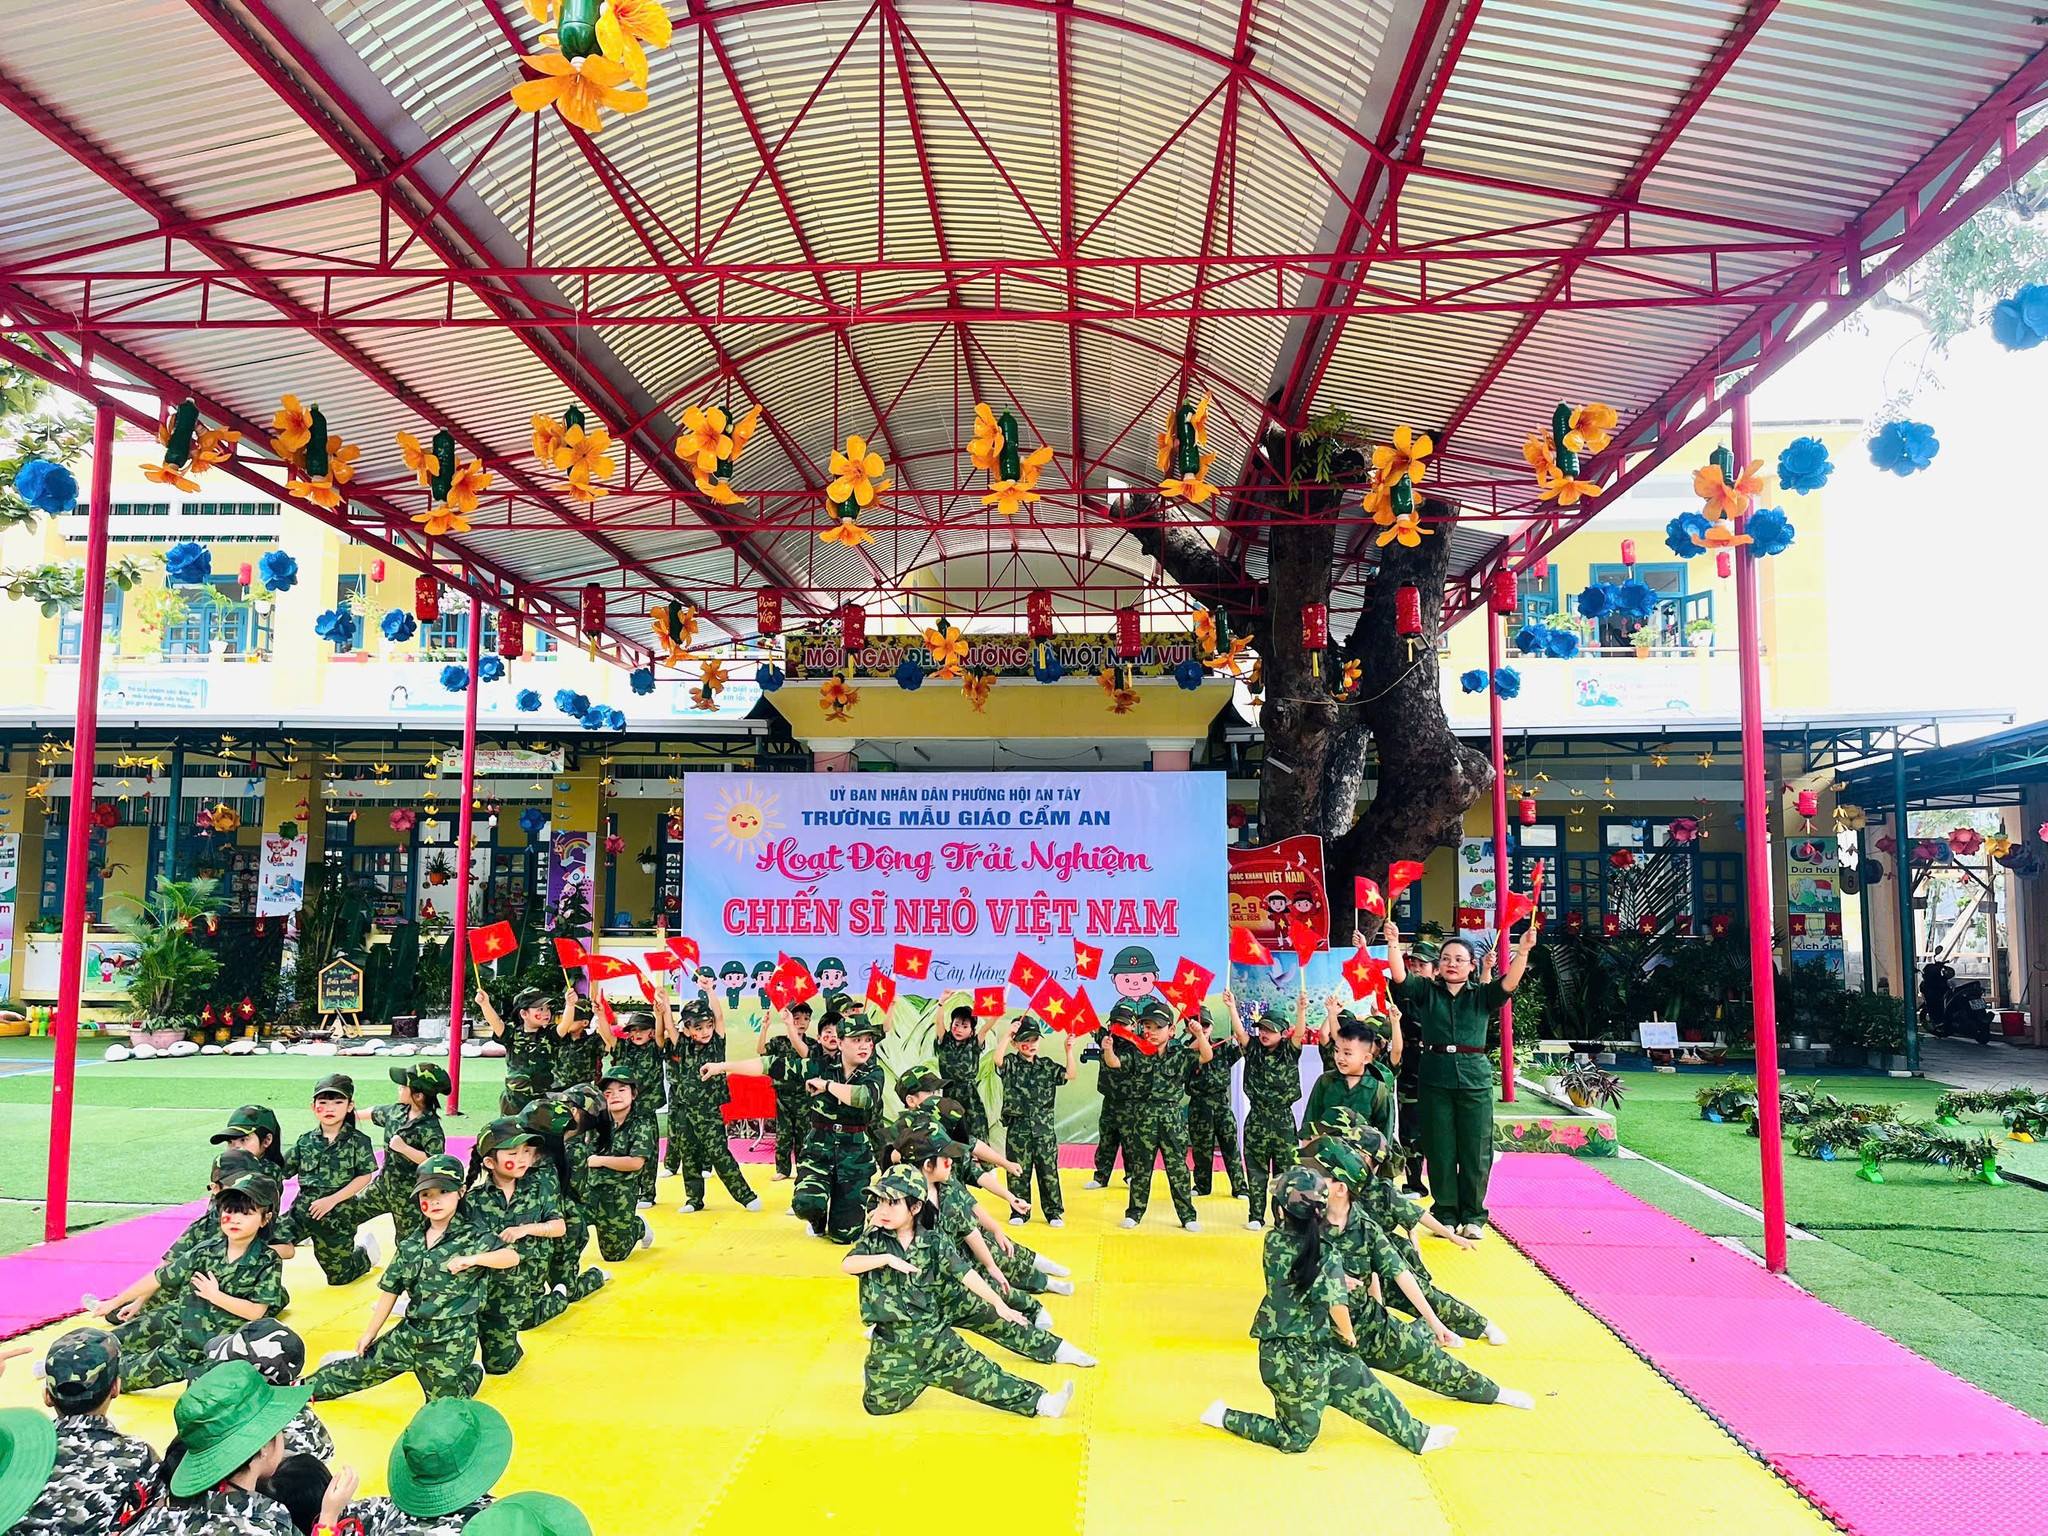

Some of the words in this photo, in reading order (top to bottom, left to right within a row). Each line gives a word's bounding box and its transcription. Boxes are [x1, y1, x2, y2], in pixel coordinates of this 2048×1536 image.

[805, 640, 844, 667] MỖI
[848, 642, 904, 667] NGÀY
[957, 641, 1028, 667] RƯỜNG
[1060, 641, 1102, 672] MỘT
[1107, 645, 1154, 666] NM
[1157, 644, 1191, 665] VUI
[850, 789, 877, 801] BAN
[881, 786, 917, 801] NHÂN
[921, 786, 948, 801] DÂN
[952, 786, 1005, 801] PHƯỜNG
[1009, 786, 1031, 804] HỘI
[1035, 789, 1054, 801] AN
[1057, 786, 1081, 801] TÂY
[801, 807, 891, 826] TRƯỜNG
[899, 805, 950, 826] MẪU
[958, 807, 1011, 826] GIÁO
[1019, 804, 1071, 826] CẨM
[1078, 810, 1110, 826] AN
[755, 836, 845, 883] Hoạt
[847, 842, 934, 883] Động
[941, 841, 1017, 872] Trải
[1021, 840, 1153, 883] Nghiệm
[1284, 871, 1306, 883] NAM
[723, 885, 843, 937] CHIẾN
[849, 889, 888, 937] SĨ
[894, 885, 979, 937] NHỎ
[985, 889, 1080, 944] VIỆT
[1086, 898, 1179, 937] NAM
[969, 961, 1007, 985] tháng
